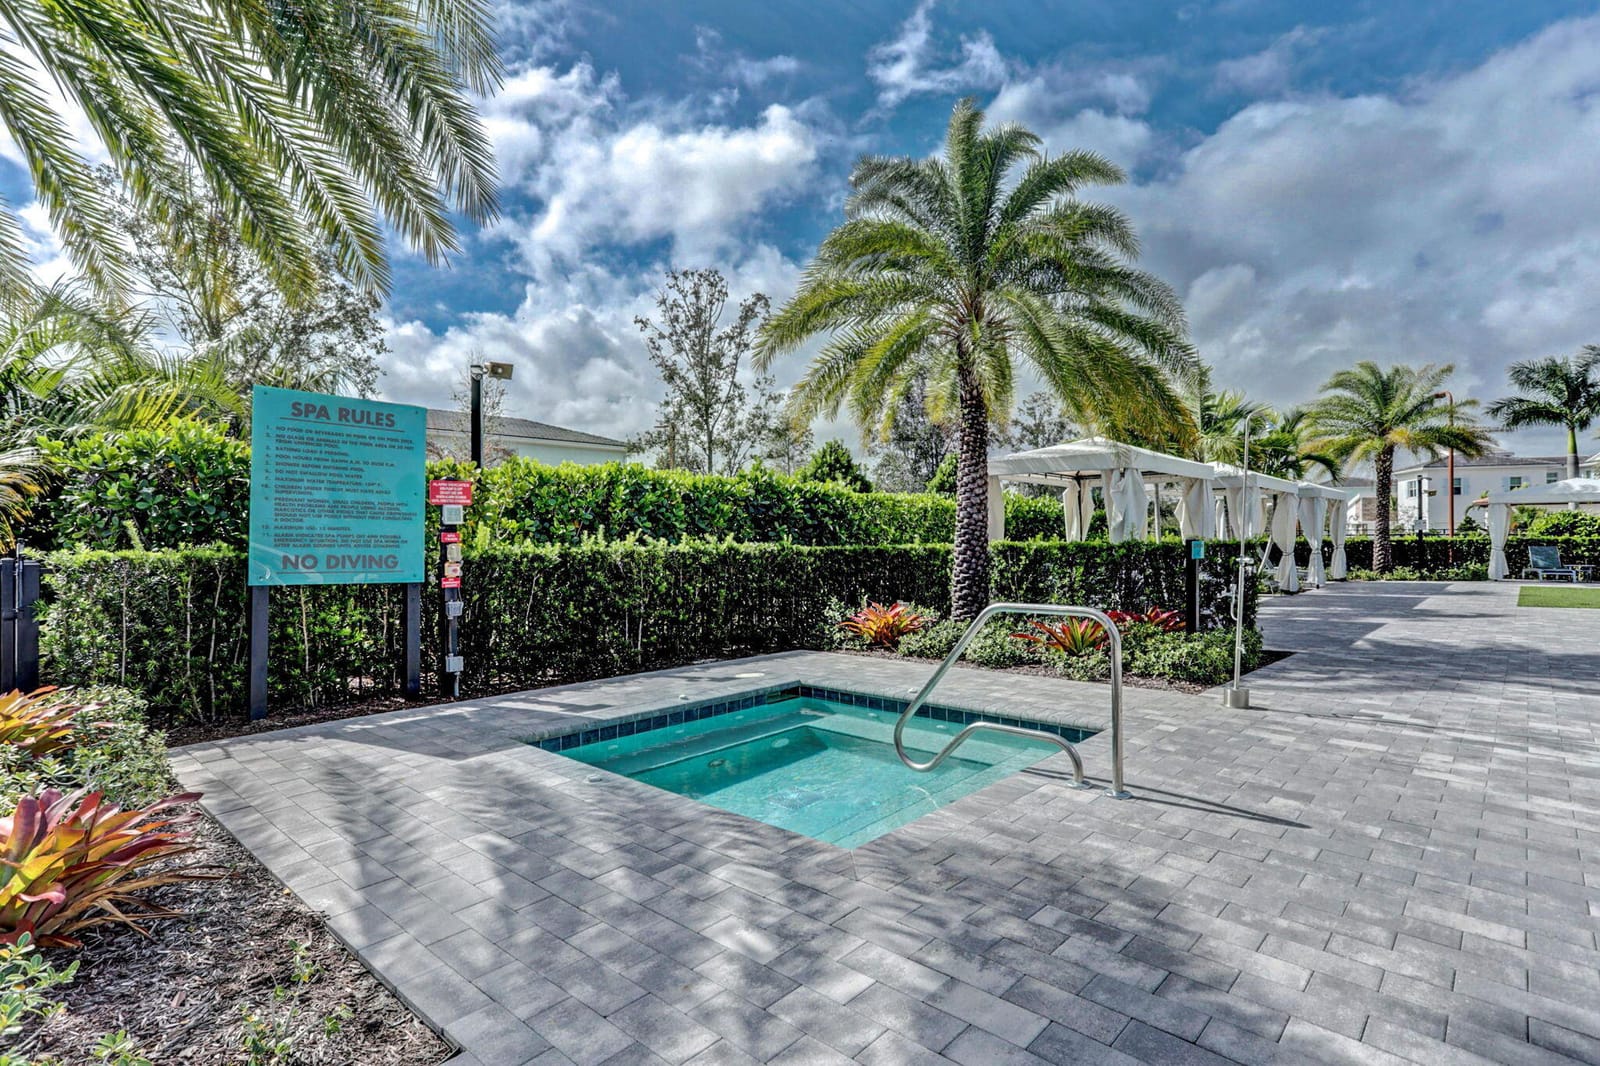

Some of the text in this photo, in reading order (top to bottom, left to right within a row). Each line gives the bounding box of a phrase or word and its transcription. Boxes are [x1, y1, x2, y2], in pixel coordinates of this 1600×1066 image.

[290, 401, 396, 427] SPA RULES
[282, 553, 399, 570] NO DIVING
